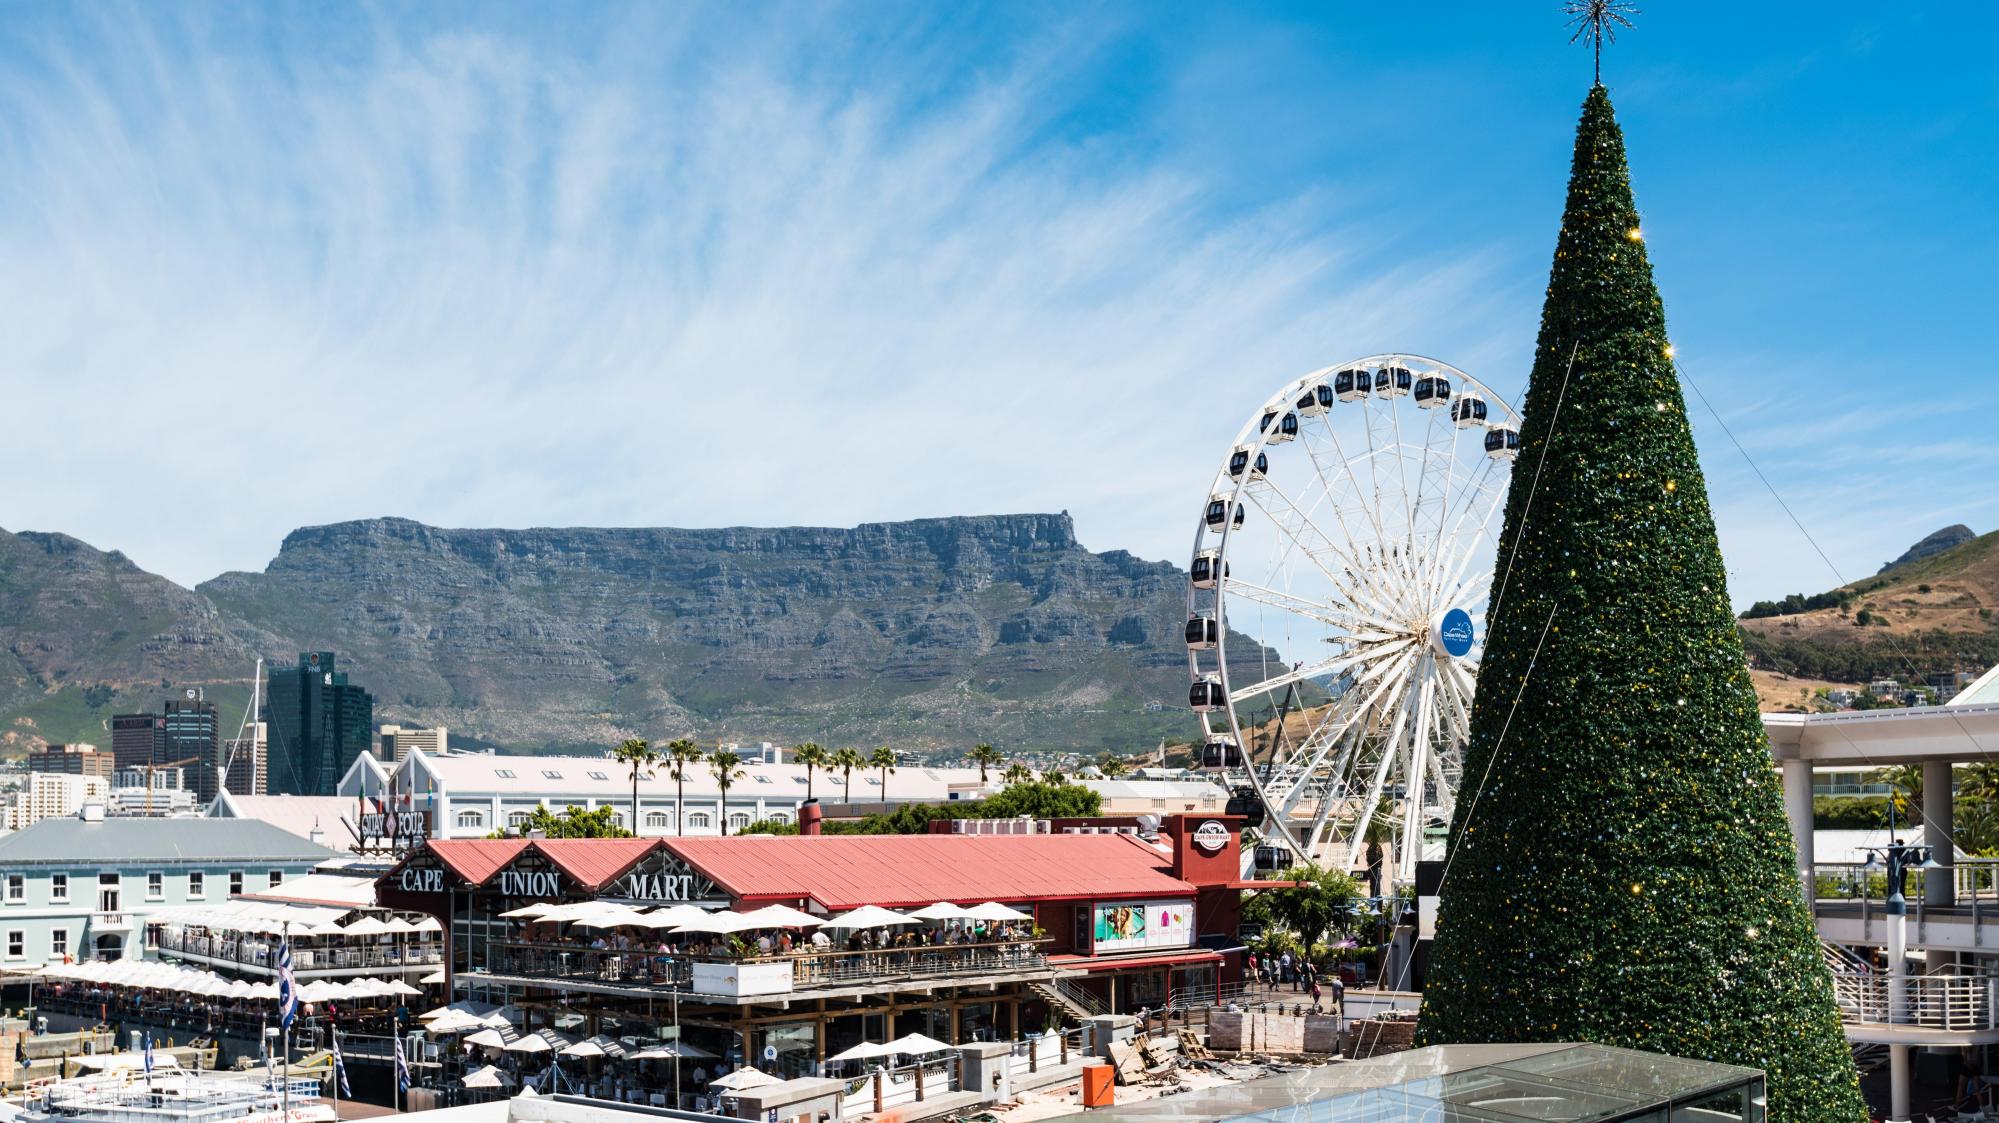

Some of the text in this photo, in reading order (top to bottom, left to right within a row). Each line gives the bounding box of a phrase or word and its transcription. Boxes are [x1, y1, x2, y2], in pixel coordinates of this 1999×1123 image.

[361, 812, 424, 836] QUAY FOUR
[402, 868, 693, 900] CAPE UNION MART
